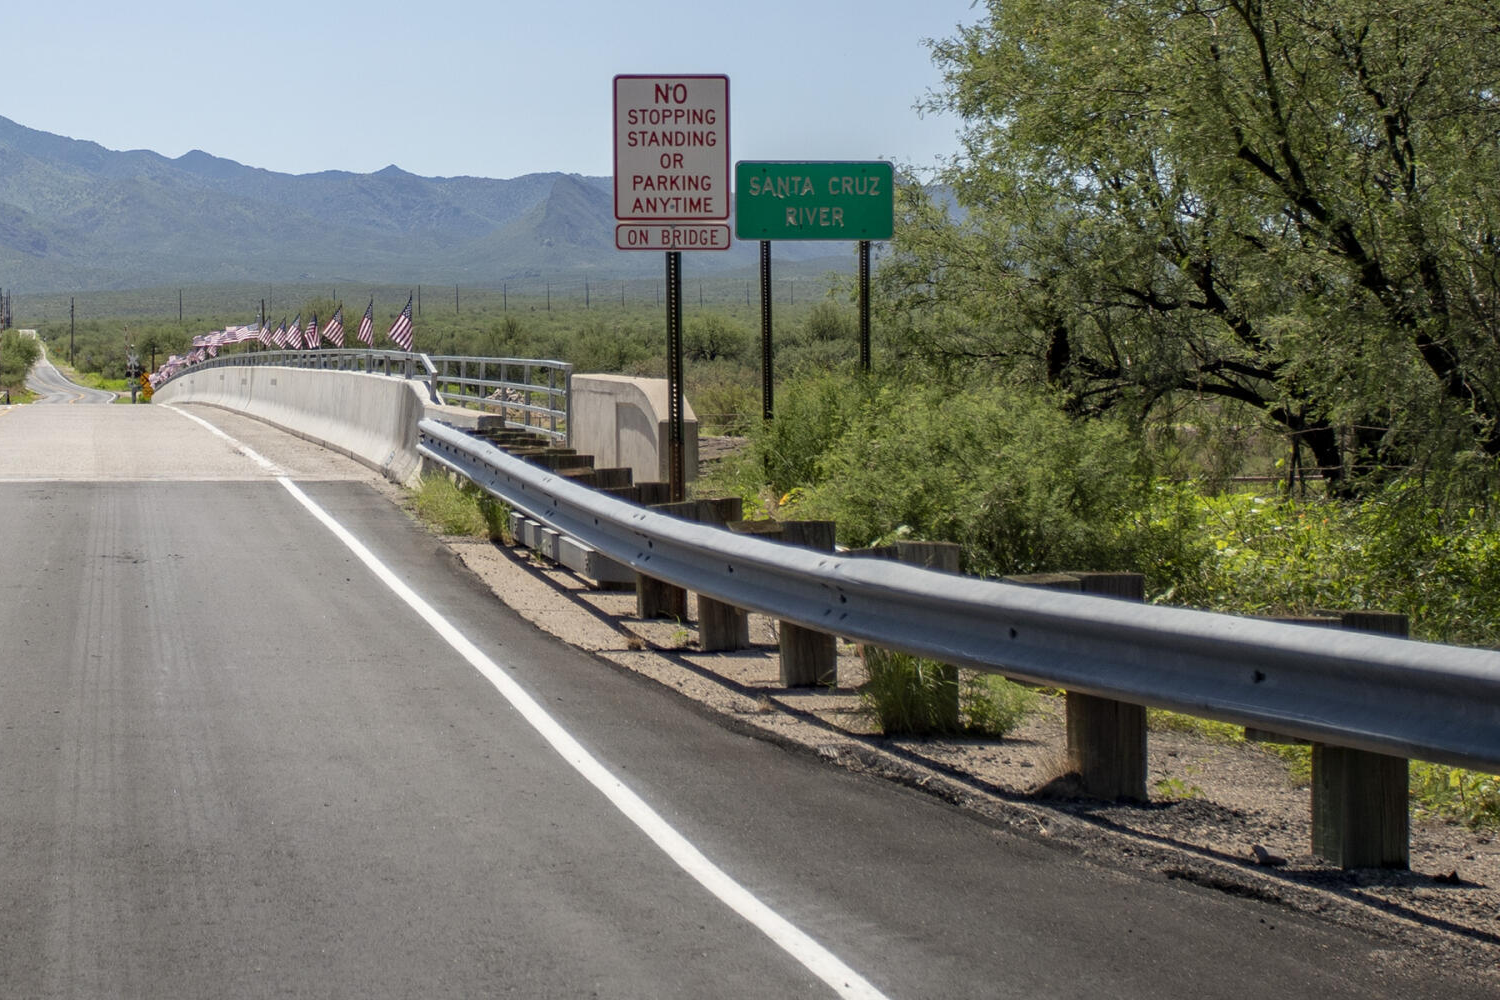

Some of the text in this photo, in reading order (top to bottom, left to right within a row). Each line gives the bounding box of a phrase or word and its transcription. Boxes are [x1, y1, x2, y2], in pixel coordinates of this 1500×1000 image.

[655, 83, 687, 104] NO
[628, 109, 716, 125] STOPPING
[627, 131, 717, 147] STANDING
[660, 153, 684, 169] OR
[632, 175, 712, 191] PARKING
[749, 176, 880, 197] SANTA CRUZ
[632, 198, 713, 213] ANYTIME
[784, 207, 844, 228] RIVER
[627, 229, 719, 246] ON BRIDGE
